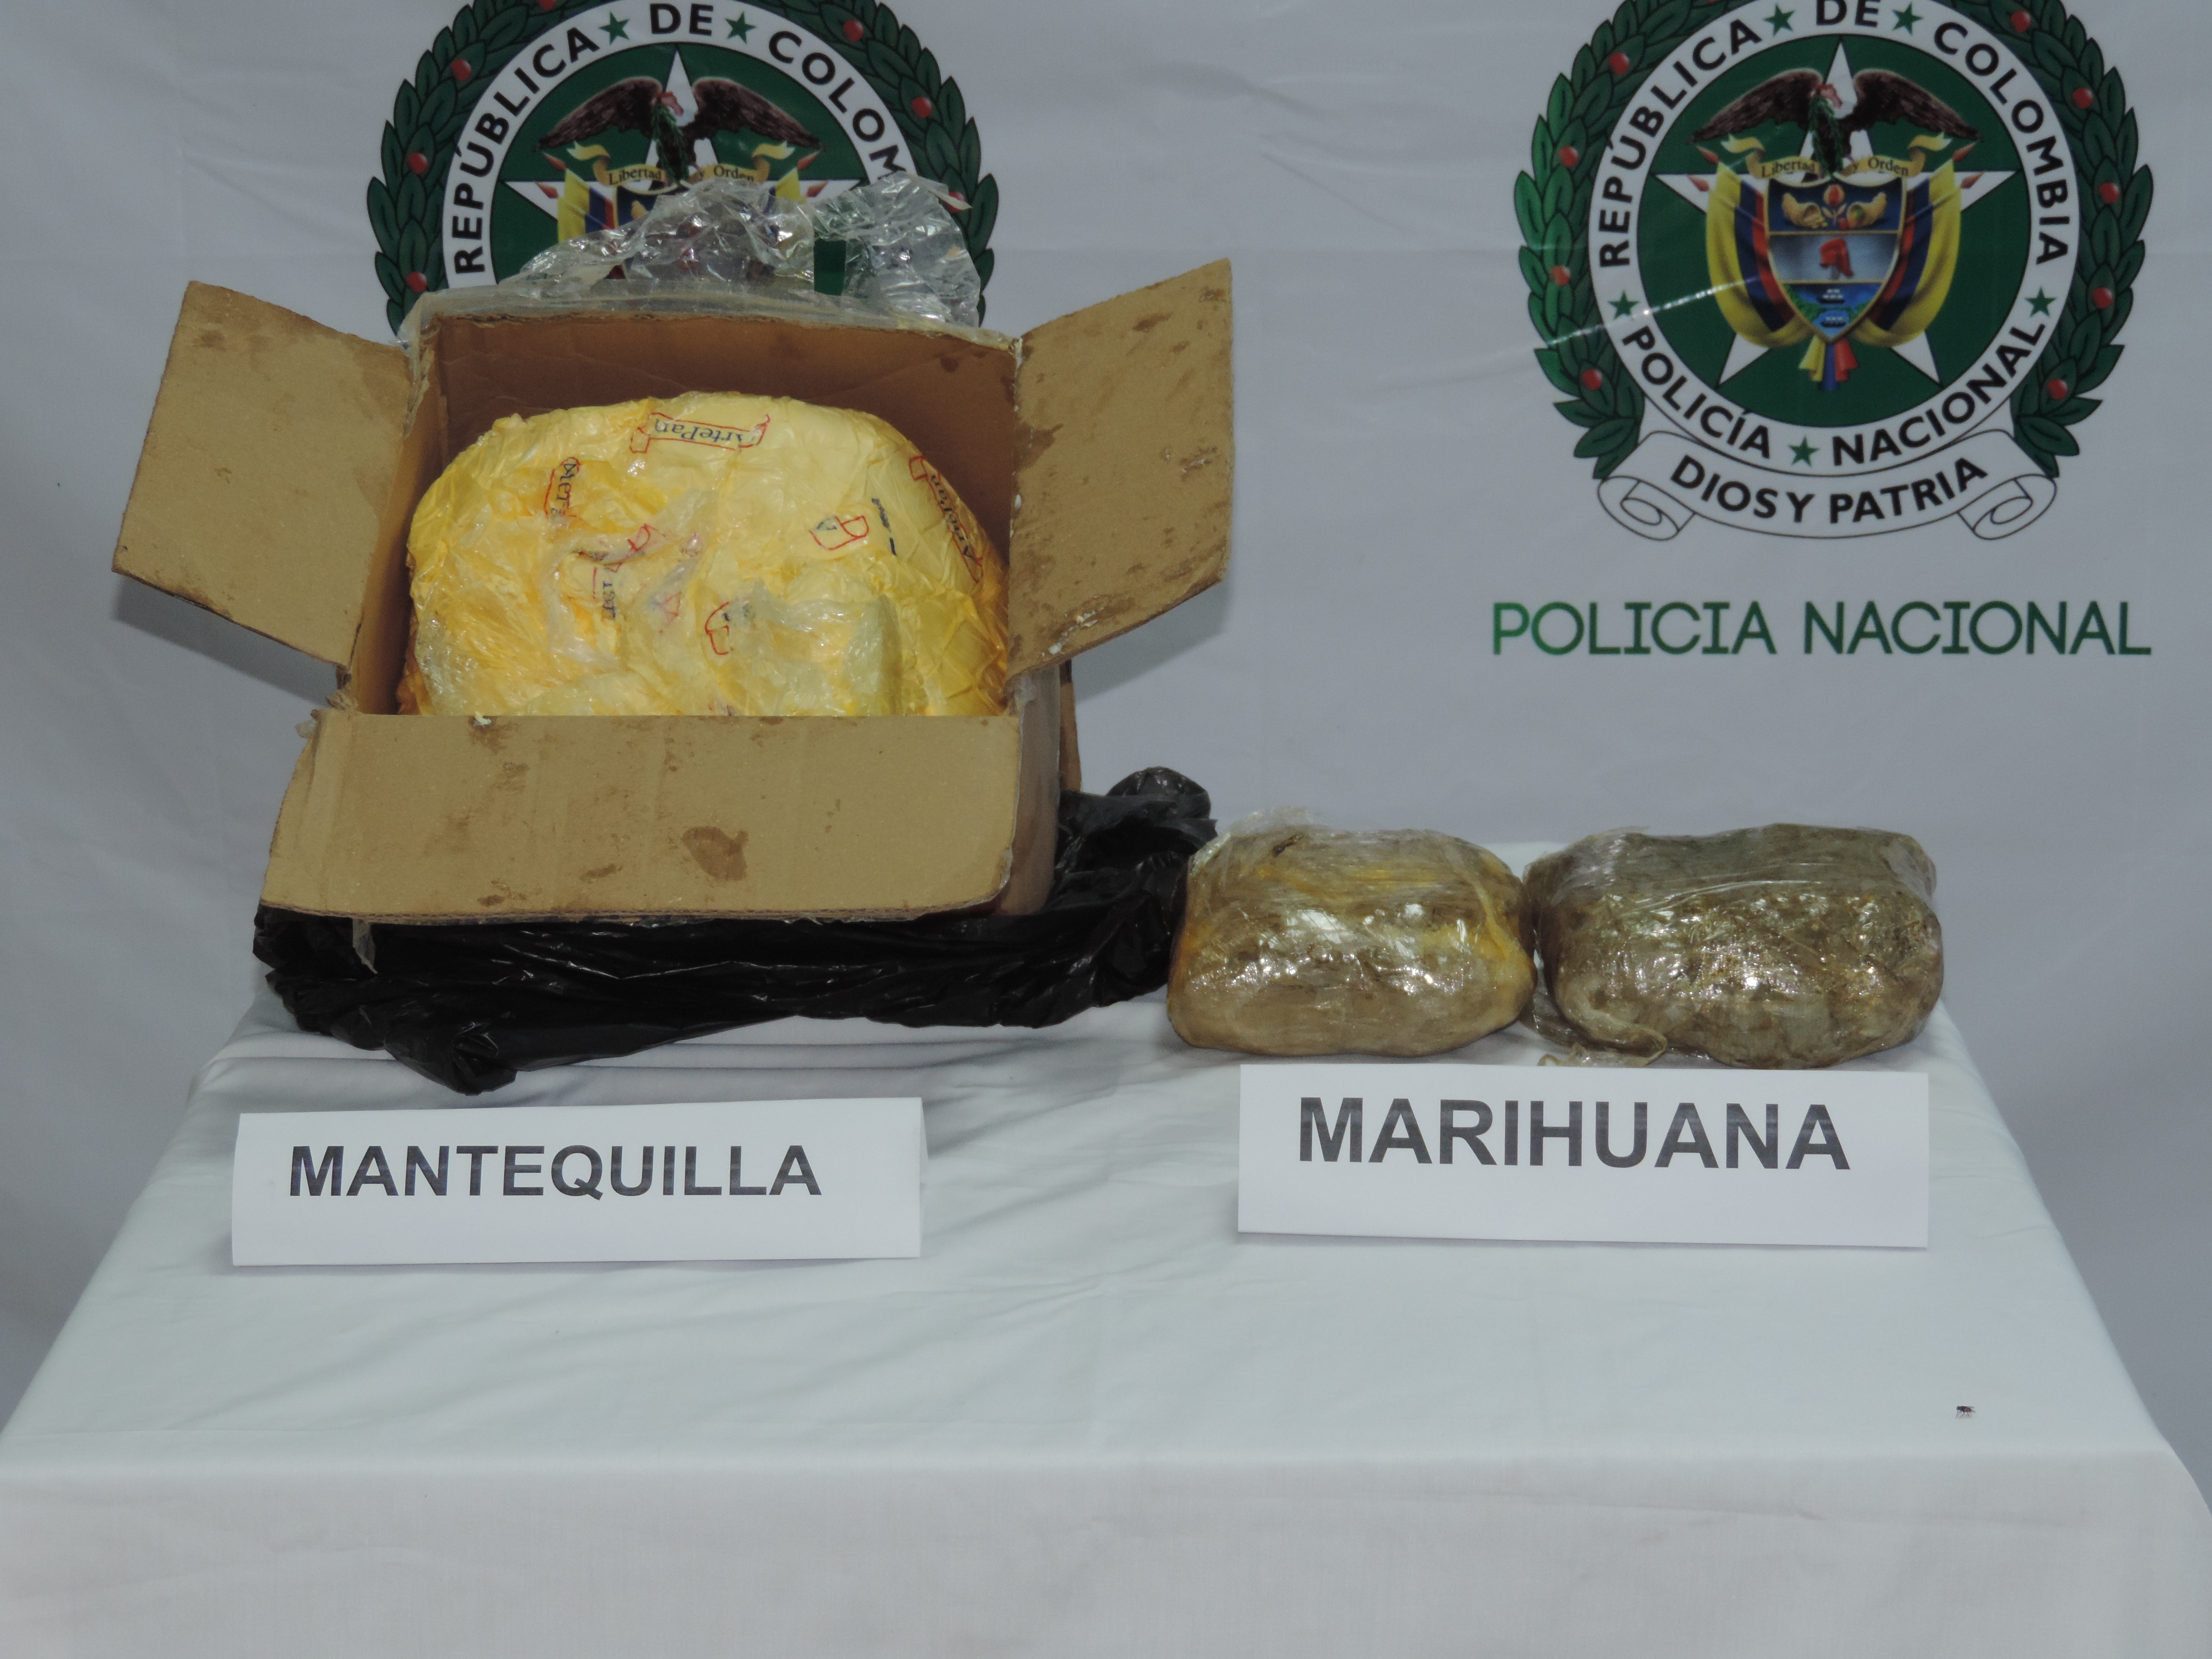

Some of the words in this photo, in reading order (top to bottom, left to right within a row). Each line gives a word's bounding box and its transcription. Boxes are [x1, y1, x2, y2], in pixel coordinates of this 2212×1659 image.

[452, 26, 600, 275] REPÚBLICA
[649, 3, 714, 37] DE
[768, 30, 907, 181] COLOM
[1598, 18, 1763, 267] REPÚBLICA
[1814, 0, 1880, 28] DE
[1934, 21, 2071, 265] COLOMBIA
[1761, 159, 1815, 178] Libertad
[1868, 157, 1910, 176] Orden
[609, 166, 661, 185] Libertad
[713, 165, 755, 183] Orden
[1621, 324, 1772, 458] POLICÍA
[1832, 321, 2046, 466] NACIONAL
[1830, 456, 1987, 524] PATRIA
[1492, 601, 1777, 655] POLICIA
[1803, 601, 2151, 655] NACIONAL
[1299, 1097, 1851, 1170] MARIHUANA
[289, 1145, 822, 1201] MANTEQUILLA
